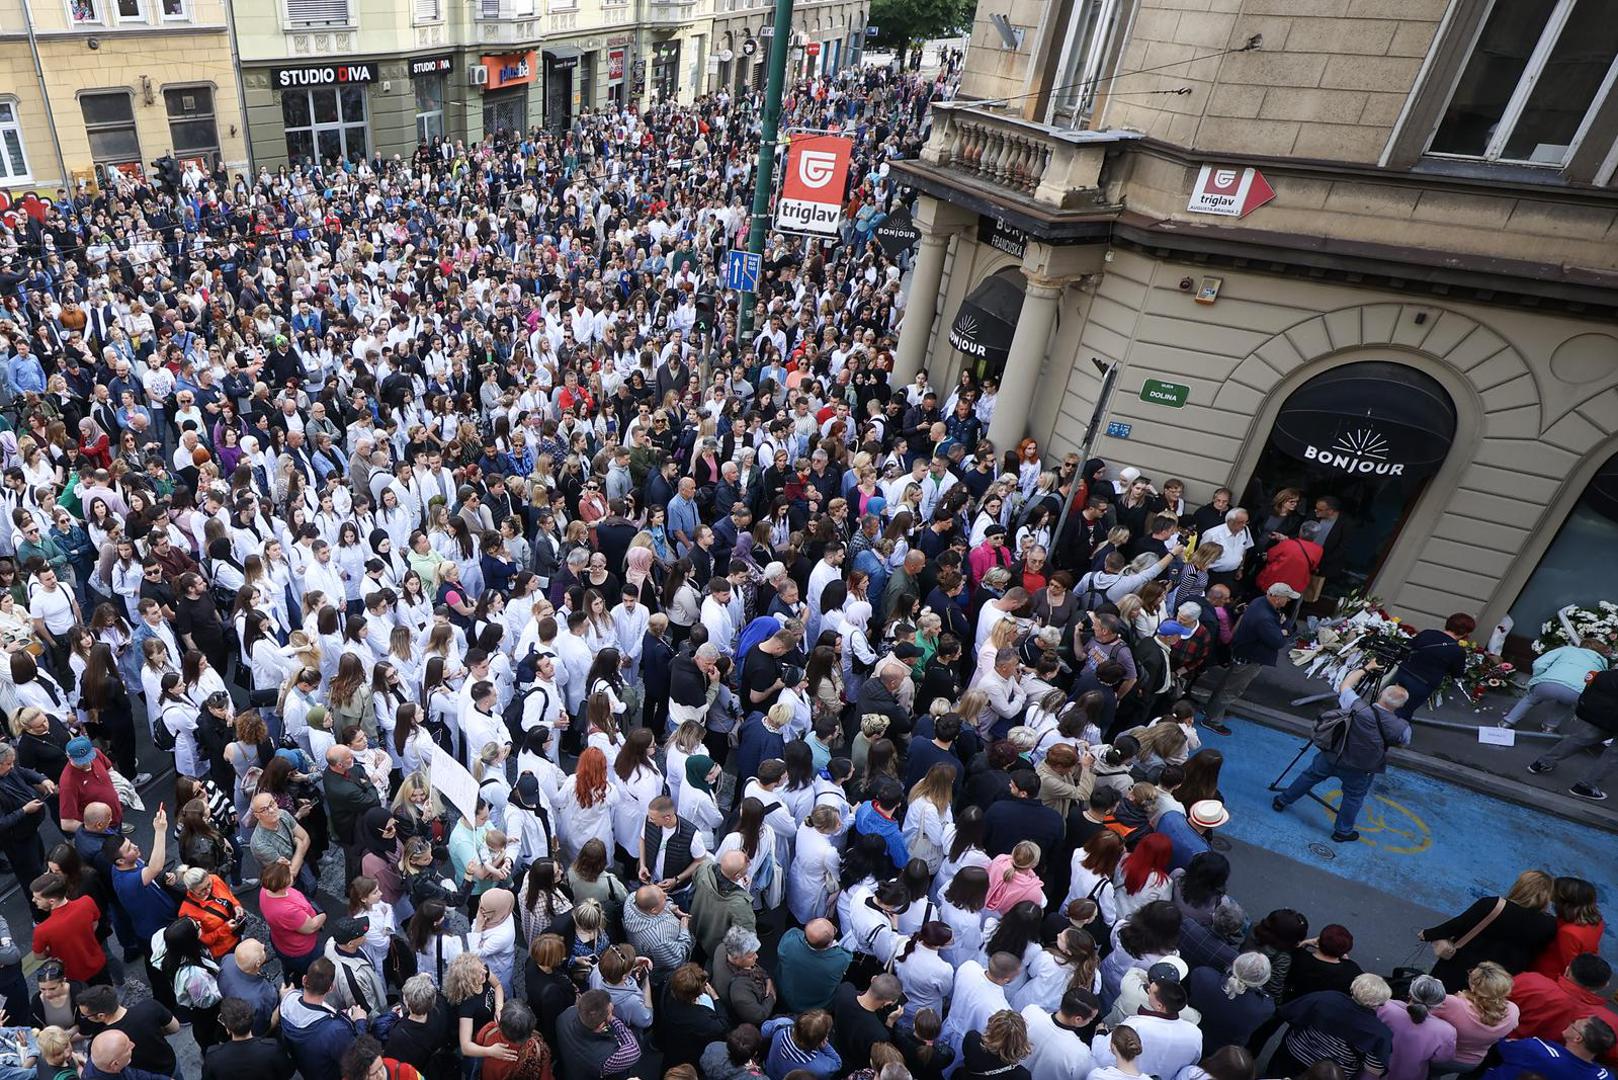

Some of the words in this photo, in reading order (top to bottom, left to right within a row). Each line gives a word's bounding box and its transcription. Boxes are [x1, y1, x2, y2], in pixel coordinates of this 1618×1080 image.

[413, 61, 436, 74] STUDIO
[279, 68, 335, 88] STUDIO
[338, 65, 371, 83] DIVA
[1200, 195, 1235, 207] triglav
[781, 202, 838, 224] triglav
[877, 227, 916, 240] BONJOUR
[949, 328, 987, 357] ONJOUR
[1149, 390, 1177, 401] DOLINA
[1304, 445, 1405, 476] BONJOUR
